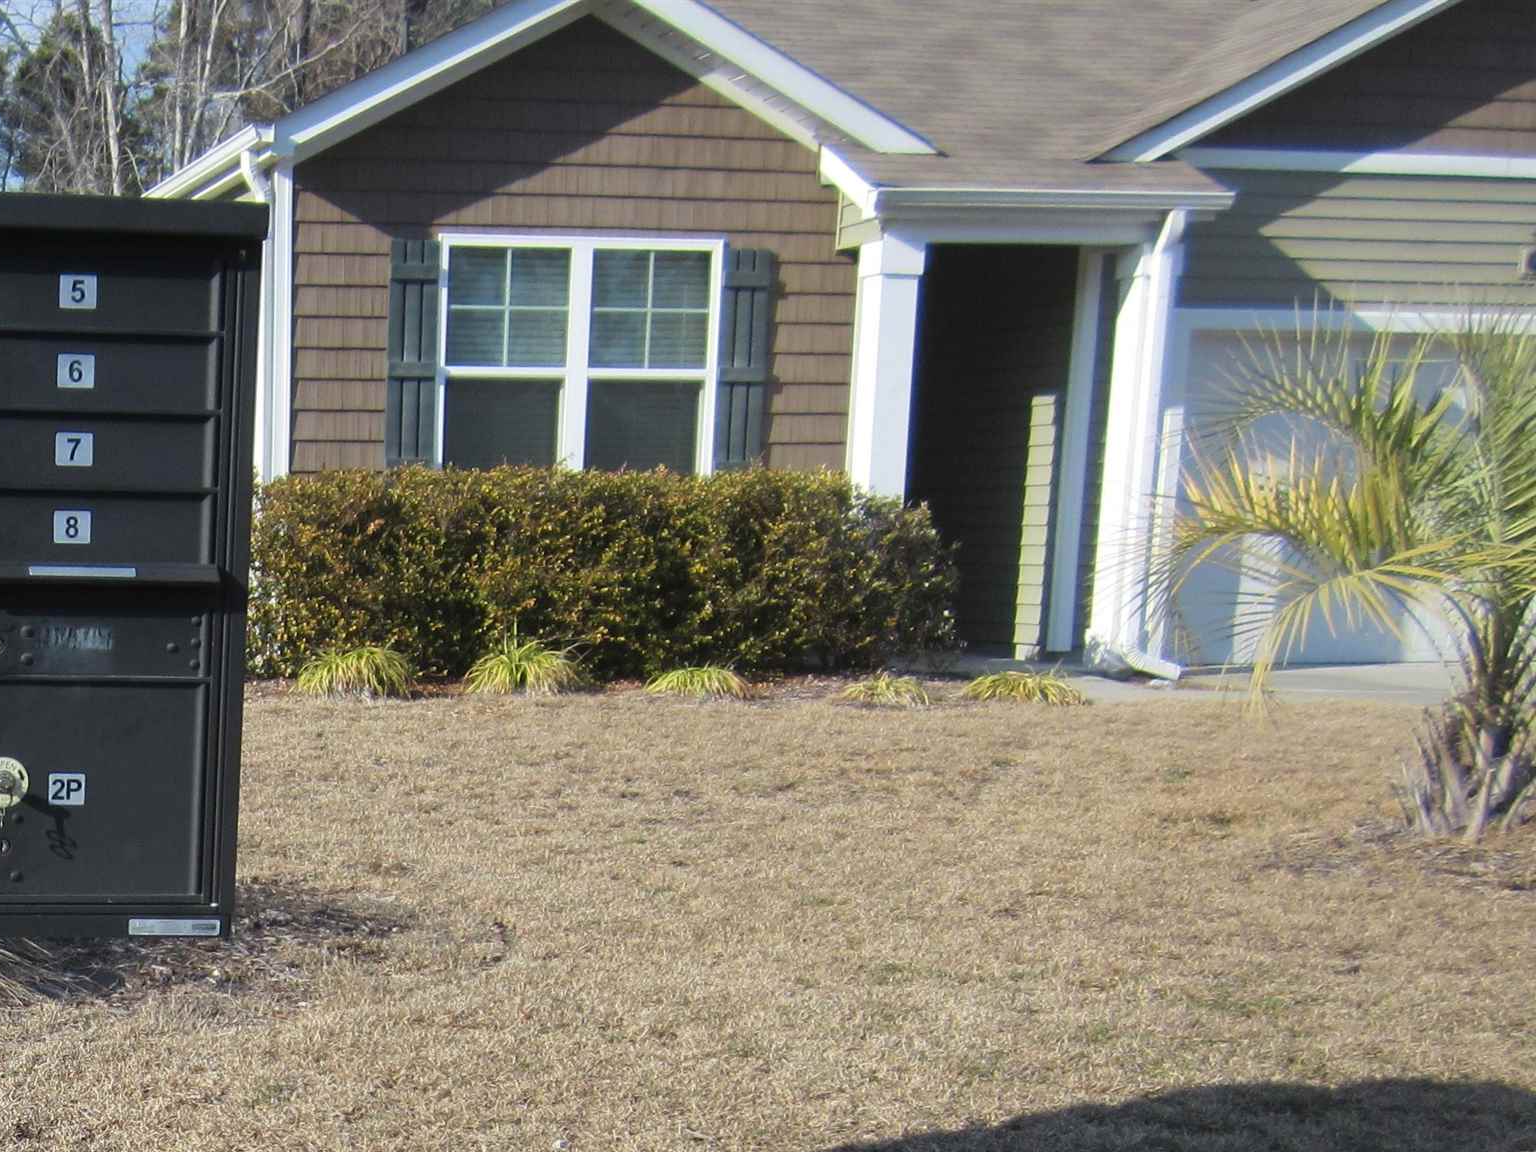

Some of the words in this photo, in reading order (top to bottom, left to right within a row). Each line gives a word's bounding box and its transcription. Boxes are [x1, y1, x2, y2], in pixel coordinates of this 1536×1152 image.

[71, 279, 86, 304] 5
[68, 359, 83, 383] 6
[66, 437, 82, 462] 7
[65, 515, 80, 539] 8
[51, 778, 84, 801] 2P
